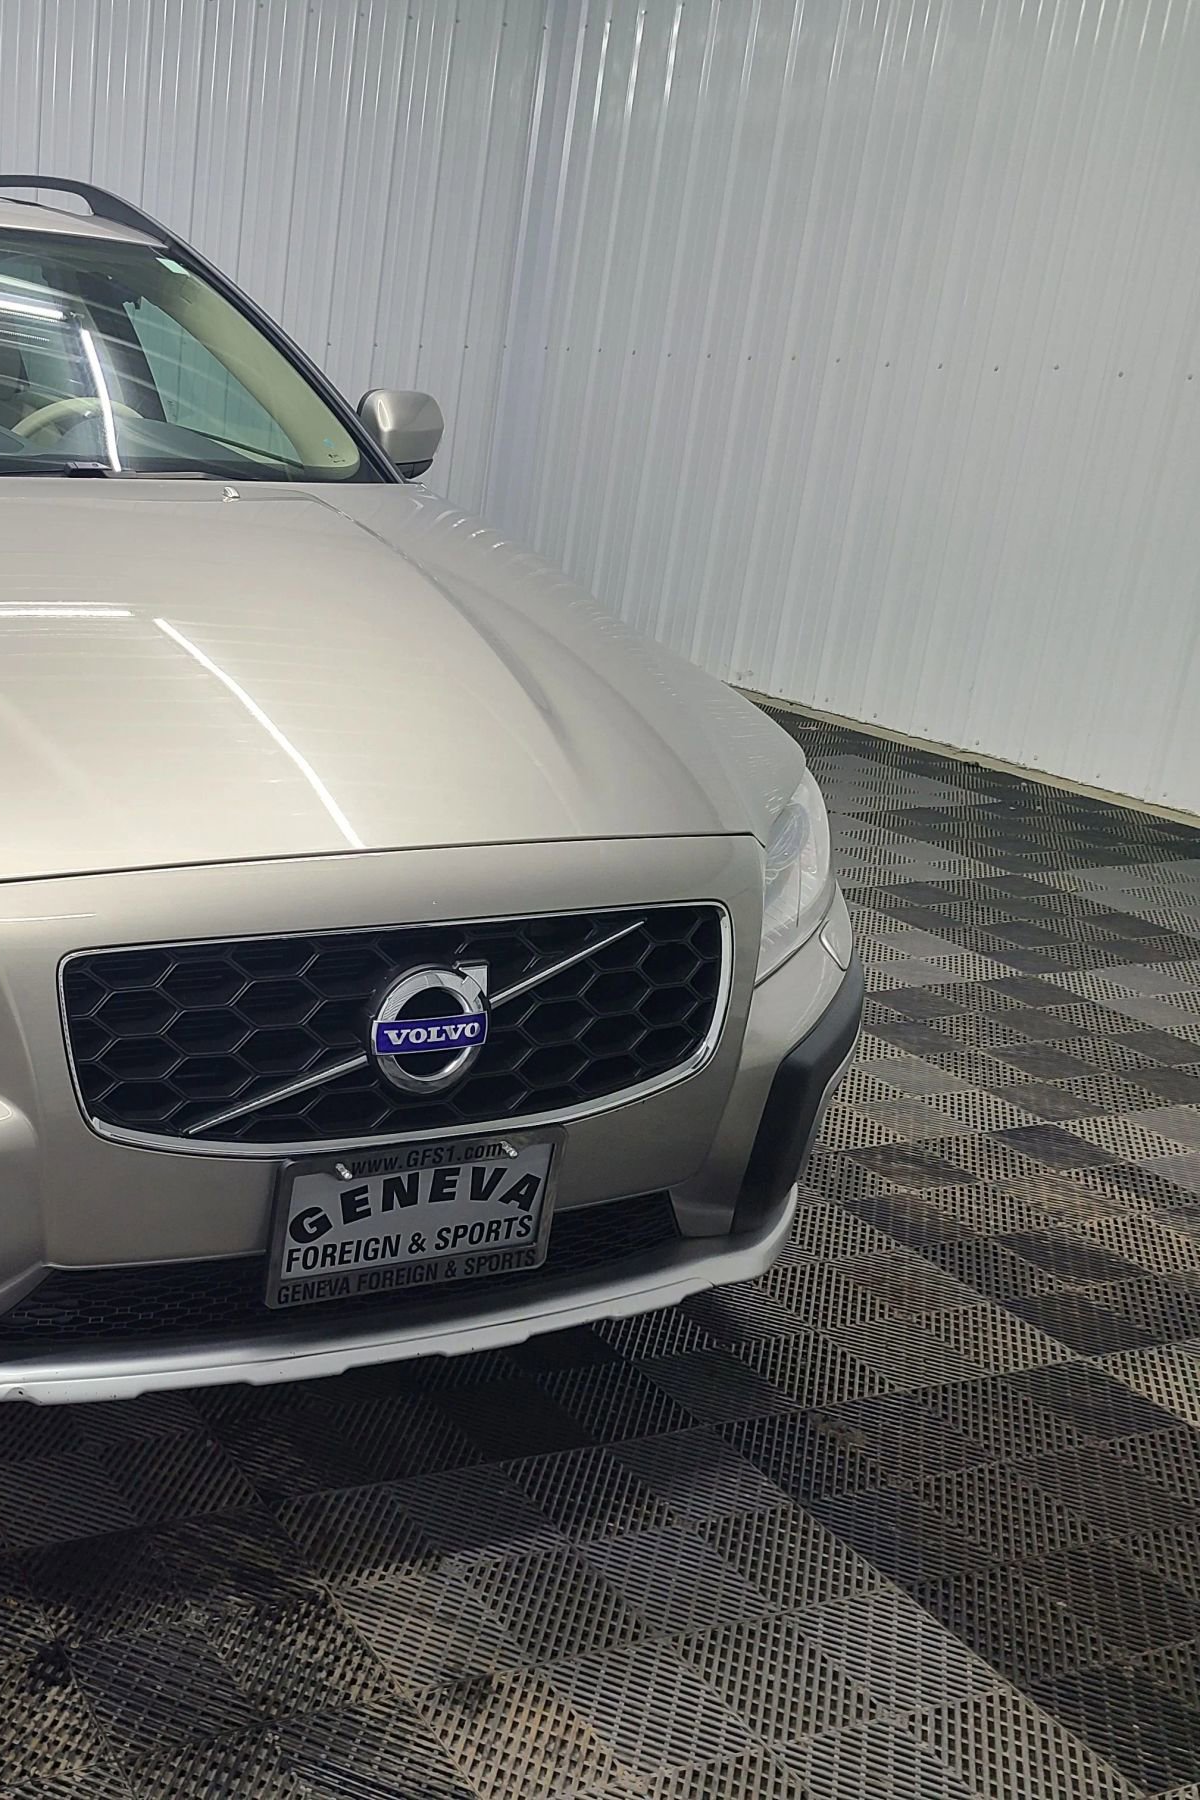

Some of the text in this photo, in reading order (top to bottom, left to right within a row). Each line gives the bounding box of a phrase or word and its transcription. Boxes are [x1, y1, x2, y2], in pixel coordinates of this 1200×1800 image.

[384, 1022, 481, 1045] VOLVO
[351, 1143, 502, 1175] www.GFS1.com
[289, 1166, 542, 1244] GENEVA
[286, 1214, 533, 1272] FOREIGN & SPORTS
[277, 1249, 536, 1304] GENEVA FOREIGN & SPORTS
